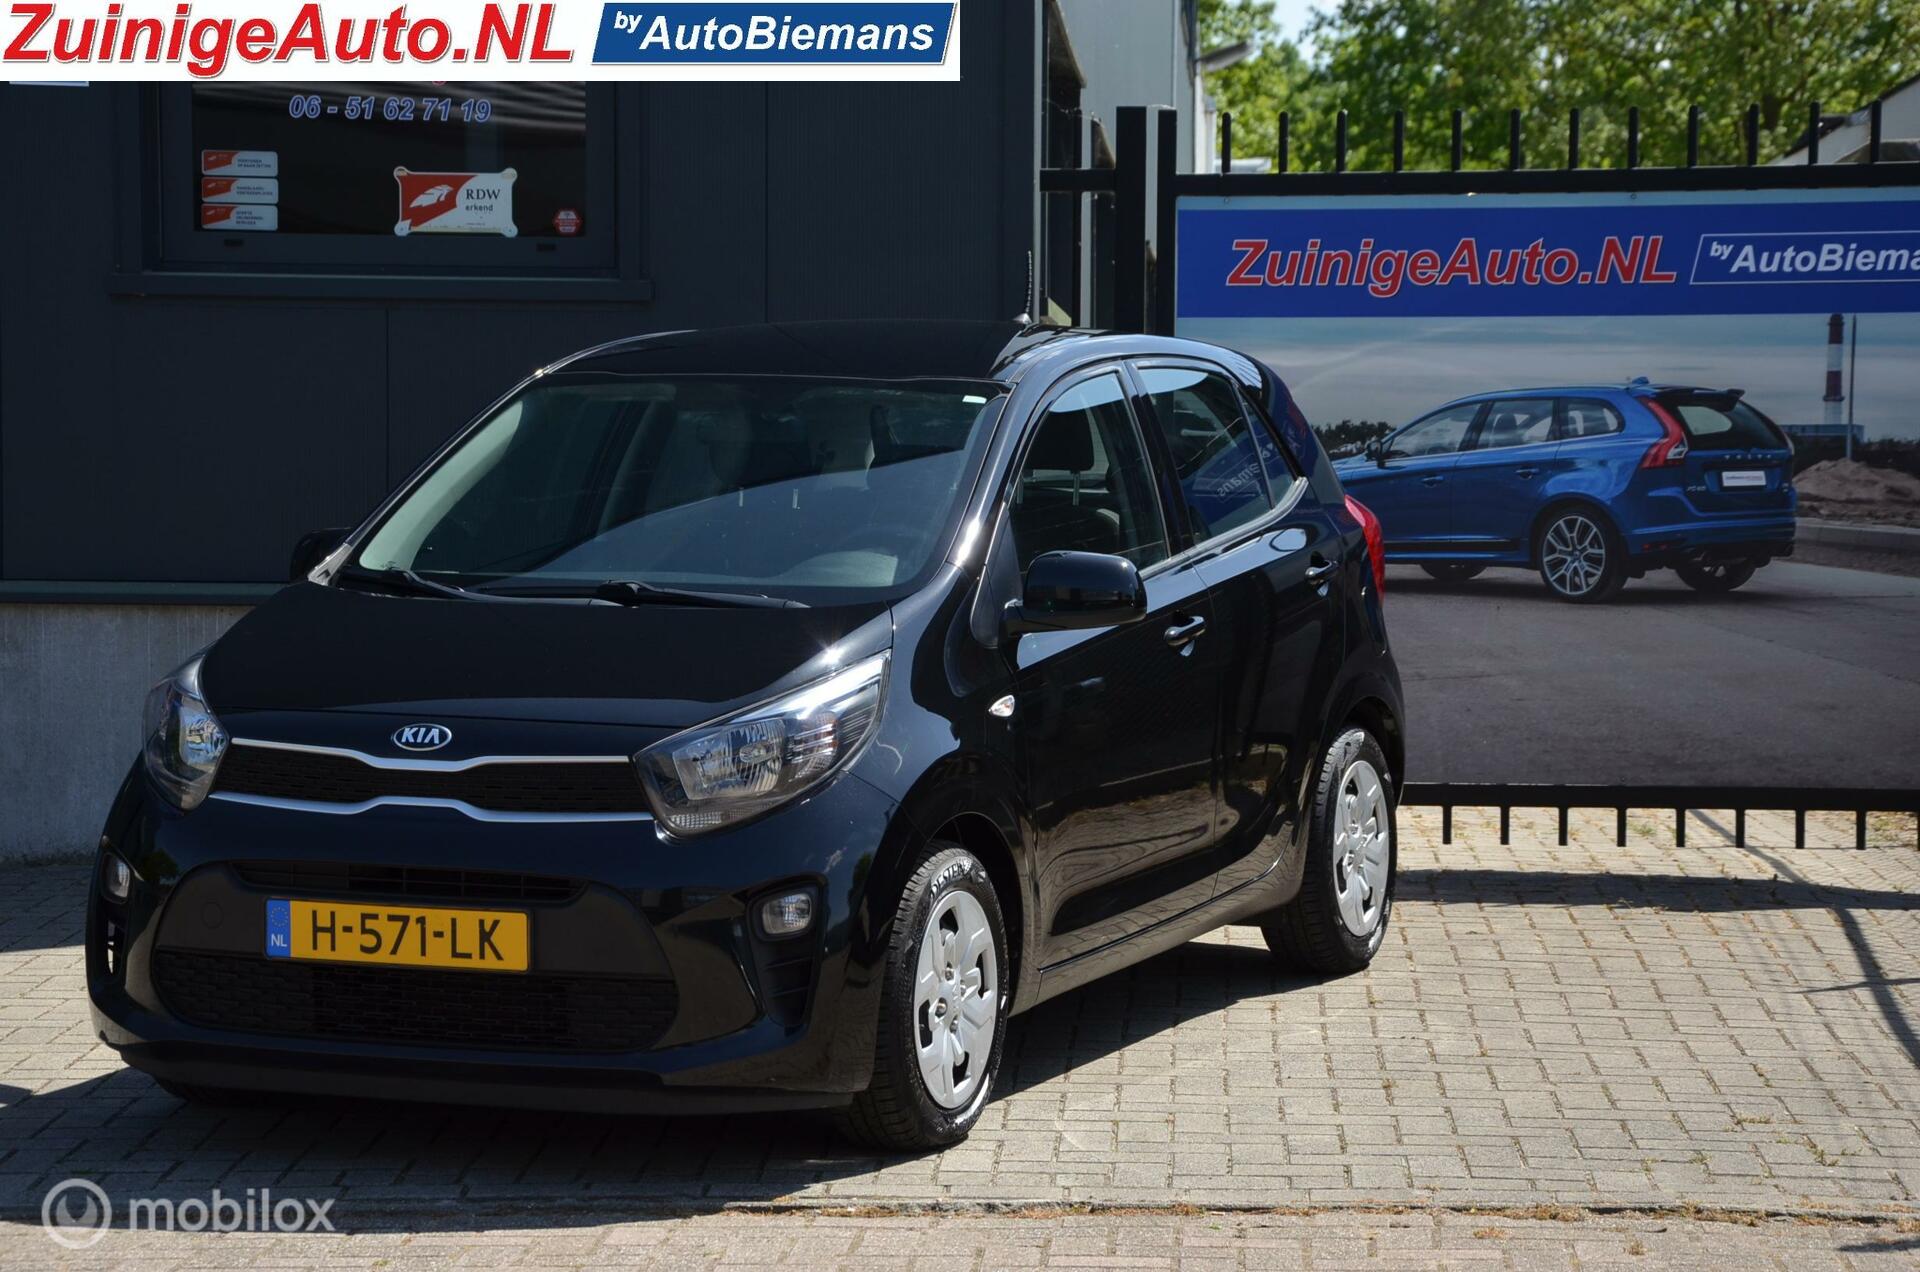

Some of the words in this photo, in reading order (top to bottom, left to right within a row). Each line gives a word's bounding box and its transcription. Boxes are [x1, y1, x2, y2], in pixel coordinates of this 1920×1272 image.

[289, 95, 321, 118] 06
[345, 96, 375, 119] 51
[384, 97, 415, 120] 62
[423, 98, 451, 121] 71
[461, 99, 491, 122] 19
[466, 189, 501, 200] RDW
[465, 203, 494, 211] erkend
[1226, 236, 1677, 298] ZuinigeAuto.NL
[1710, 241, 1734, 260] by
[401, 727, 440, 745] KIA
[271, 934, 288, 948] NL
[312, 910, 504, 961] H-571-LK
